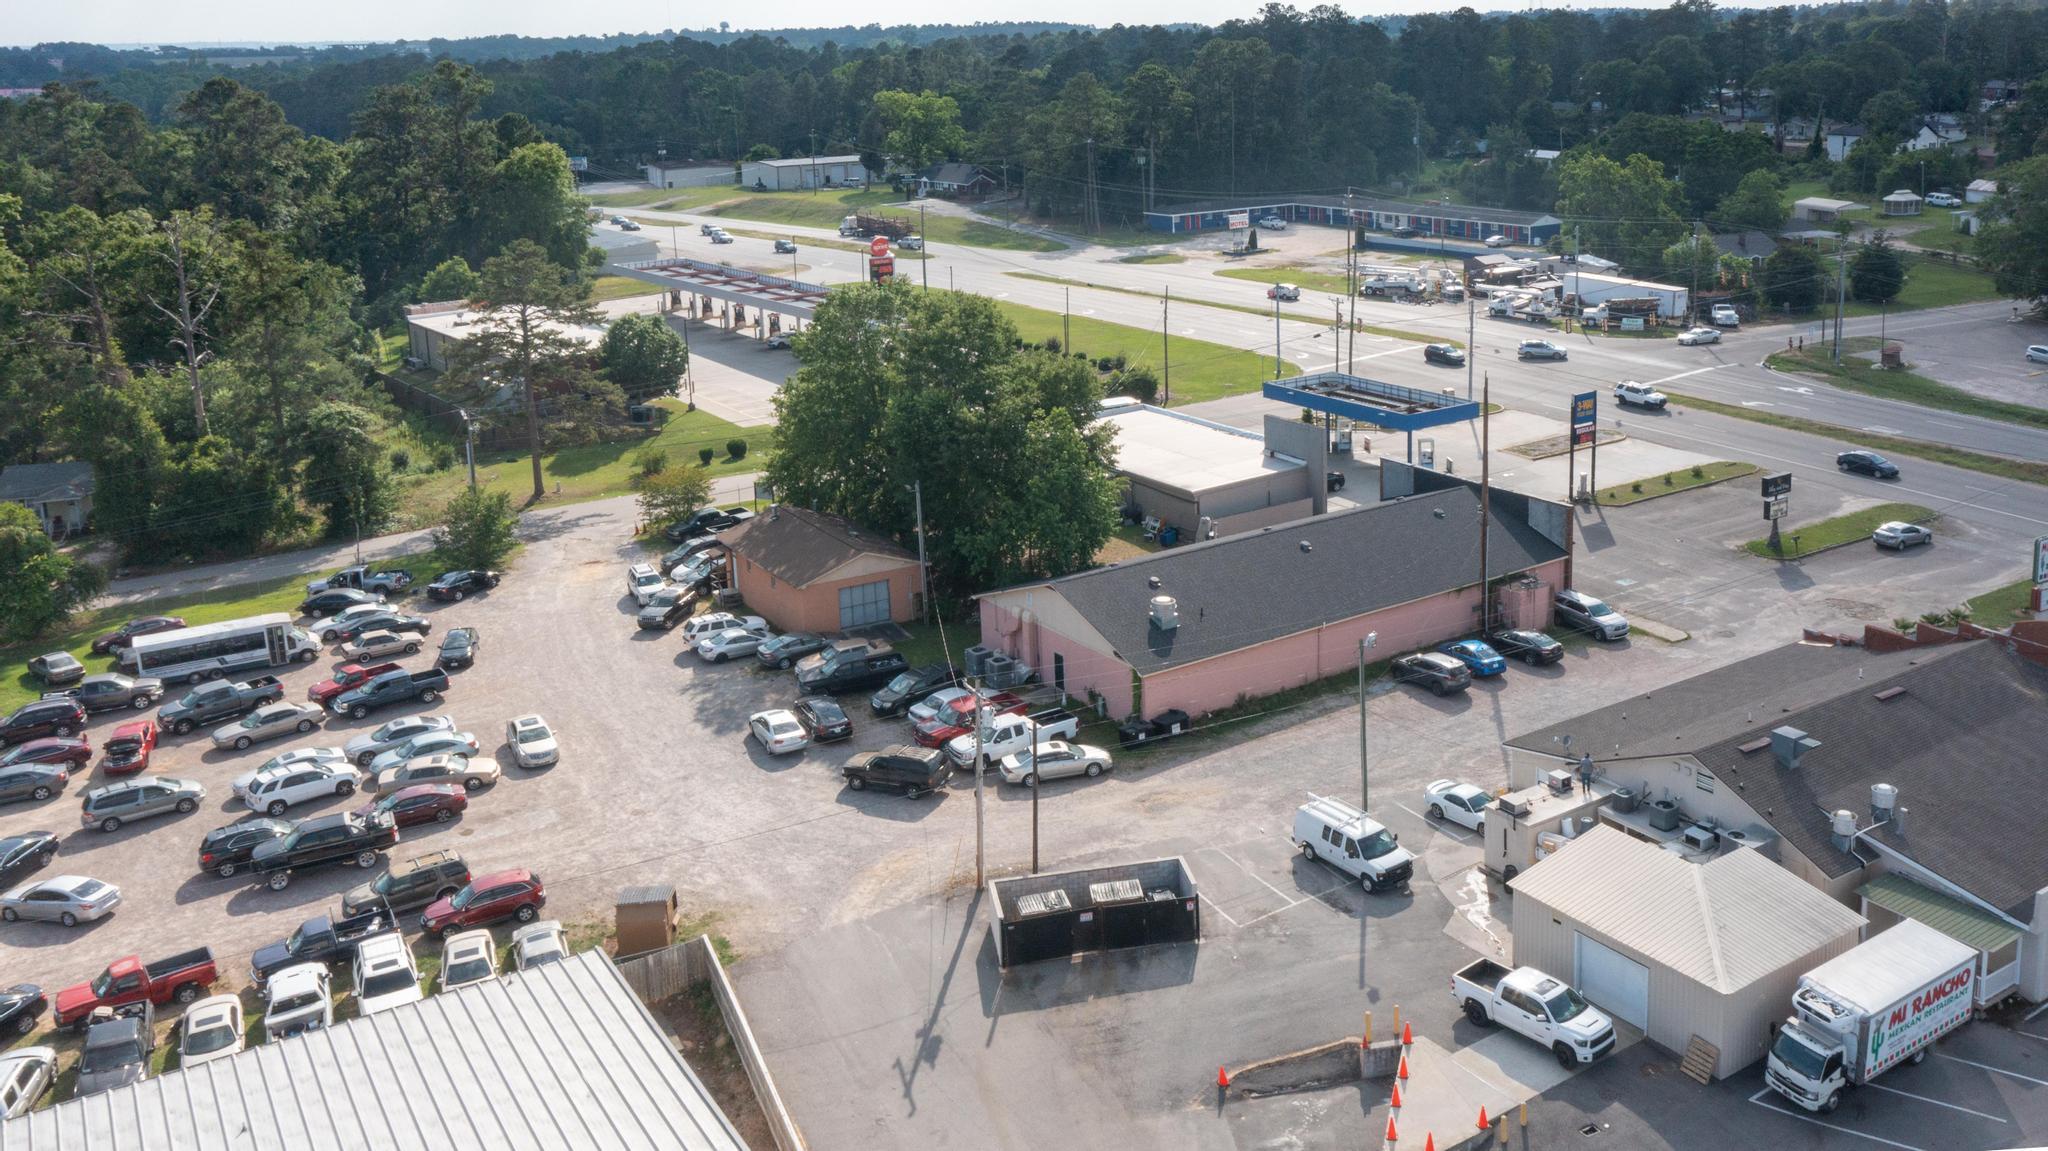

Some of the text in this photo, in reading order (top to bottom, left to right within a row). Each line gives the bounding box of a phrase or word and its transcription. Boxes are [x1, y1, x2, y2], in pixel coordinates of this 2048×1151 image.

[1231, 220, 1249, 228] MOTEL
[1888, 967, 1971, 1030] MI RANCHO
[1888, 987, 1968, 1040] MEXICAN RESTAURANT
